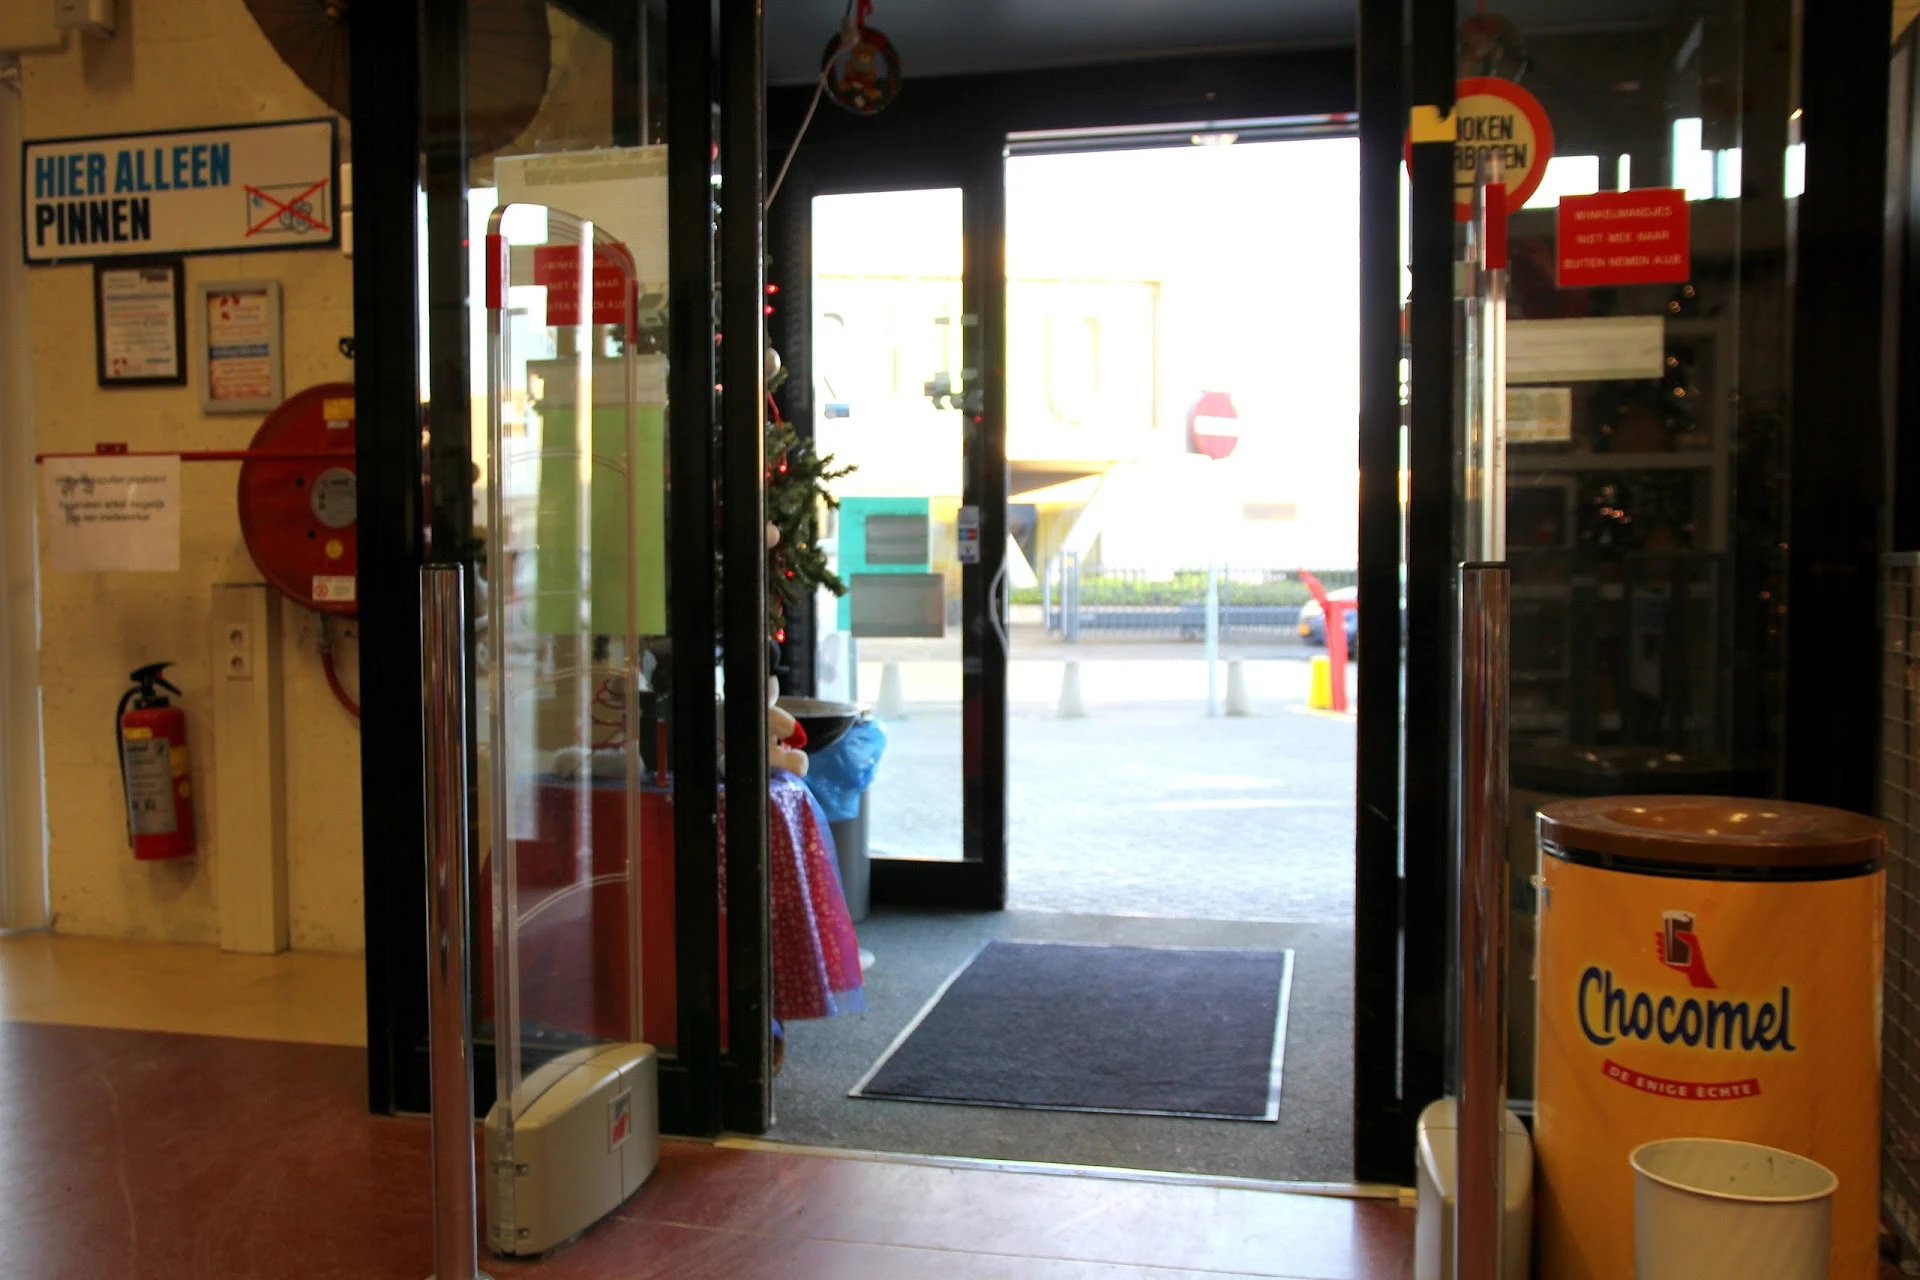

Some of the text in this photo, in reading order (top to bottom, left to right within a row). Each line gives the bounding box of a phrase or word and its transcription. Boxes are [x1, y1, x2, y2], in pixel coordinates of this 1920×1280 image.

[1456, 115, 1515, 141] OKEN
[35, 142, 231, 198] HIER ALLEEN
[35, 197, 150, 246] PINNEN
[1576, 229, 1671, 245] NIET MEE NAAR
[1563, 256, 1606, 270] BUITEN
[1607, 254, 1650, 267] NEMEN
[1579, 966, 1797, 1051] Chocomel
[1607, 1065, 1630, 1083] DE
[1636, 1076, 1688, 1097] ENIGE
